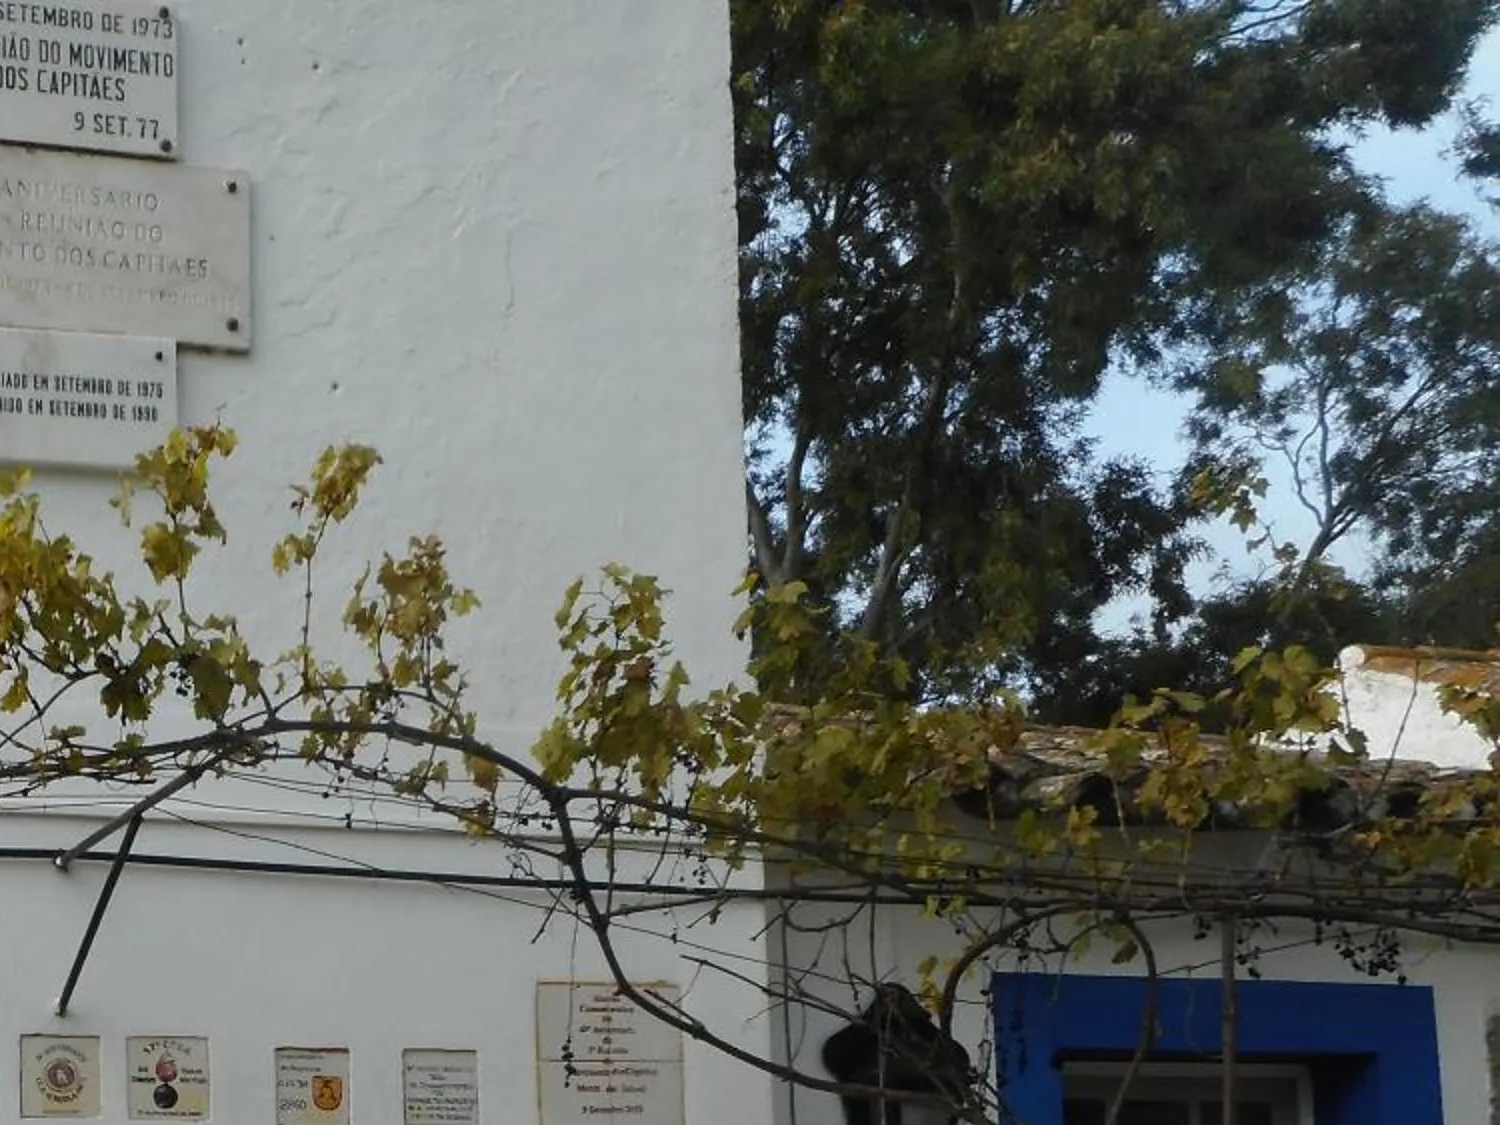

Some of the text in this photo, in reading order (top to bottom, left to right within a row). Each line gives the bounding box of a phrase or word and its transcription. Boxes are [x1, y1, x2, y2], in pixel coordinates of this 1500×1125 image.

[101, 13, 124, 33] DE
[132, 17, 173, 40] 1973
[39, 39, 61, 65] DO
[69, 41, 174, 77] MOVIMENTO
[74, 111, 85, 131] 9
[134, 222, 164, 244] DO
[54, 242, 95, 268] DOS
[33, 373, 49, 391] EM
[54, 375, 113, 396] SETEMBRO
[117, 380, 132, 397] DE
[28, 397, 43, 415] EM
[49, 400, 107, 419] SETEMBRO
[112, 403, 126, 421] DE
